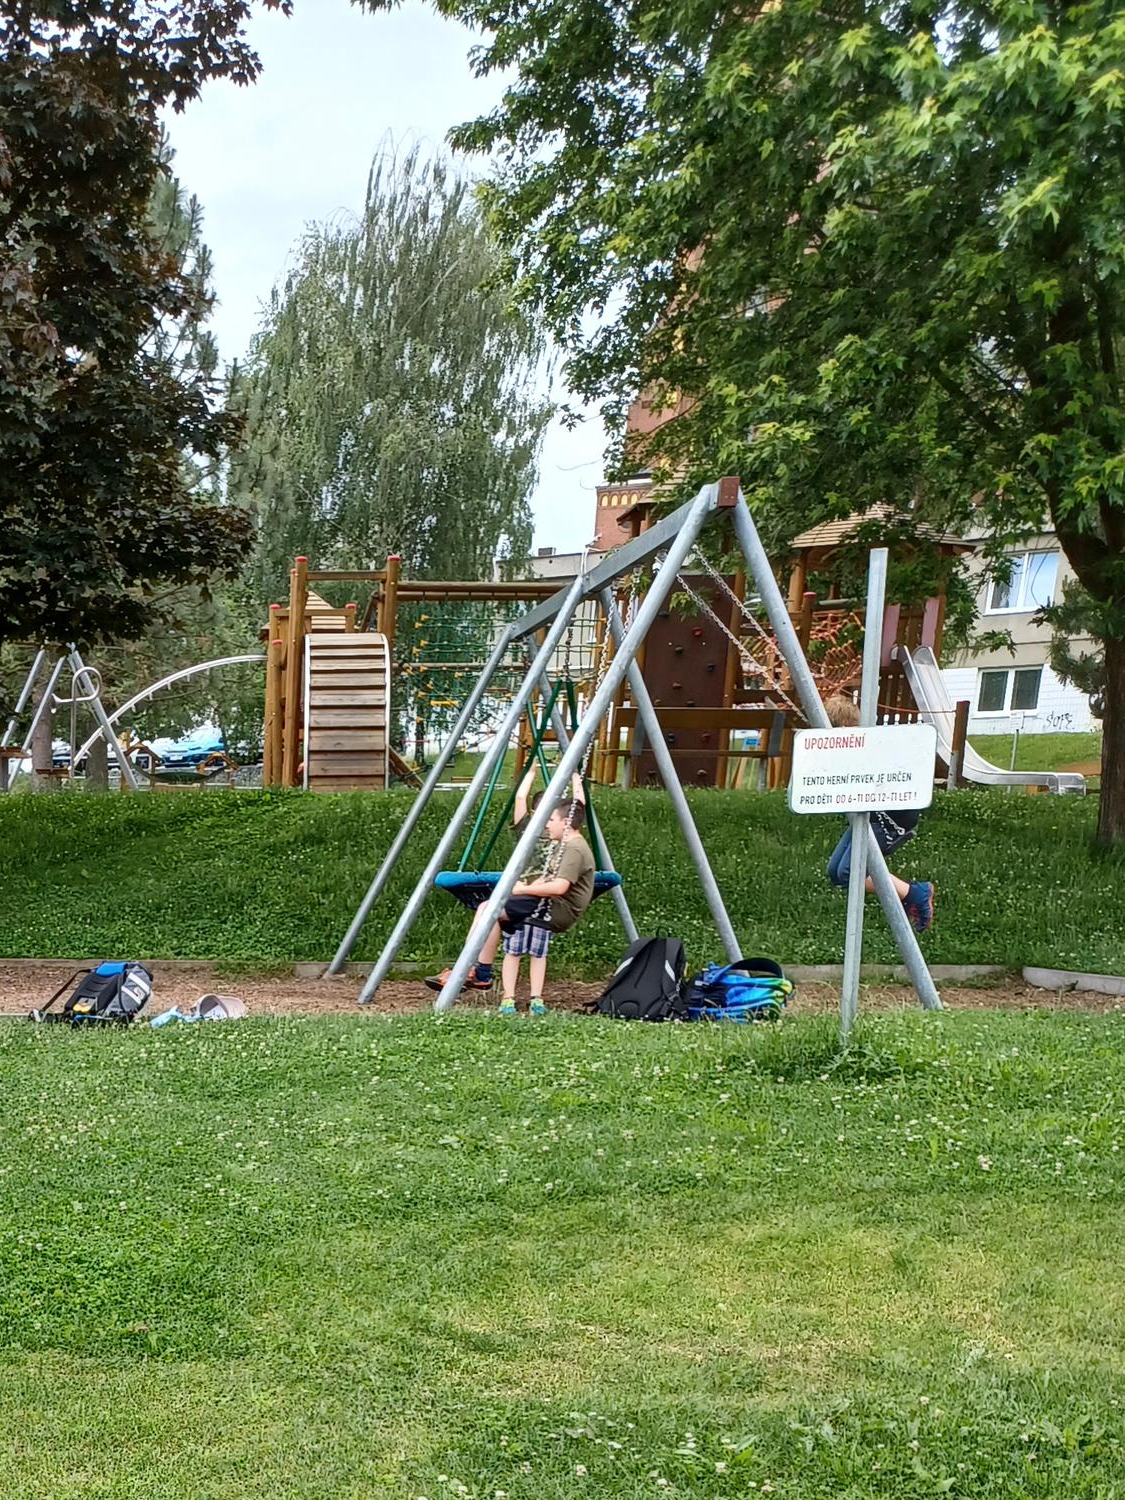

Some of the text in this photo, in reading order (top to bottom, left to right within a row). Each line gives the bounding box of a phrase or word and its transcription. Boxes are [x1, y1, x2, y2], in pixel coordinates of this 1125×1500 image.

[804, 733, 865, 750] UPOZORNĚNÍ
[803, 771, 912, 786] TENTO HERNÍ PRVEK JE URČEN
[800, 795, 815, 805] PRO
[817, 793, 832, 804] DĚTI
[899, 791, 913, 802] LET
